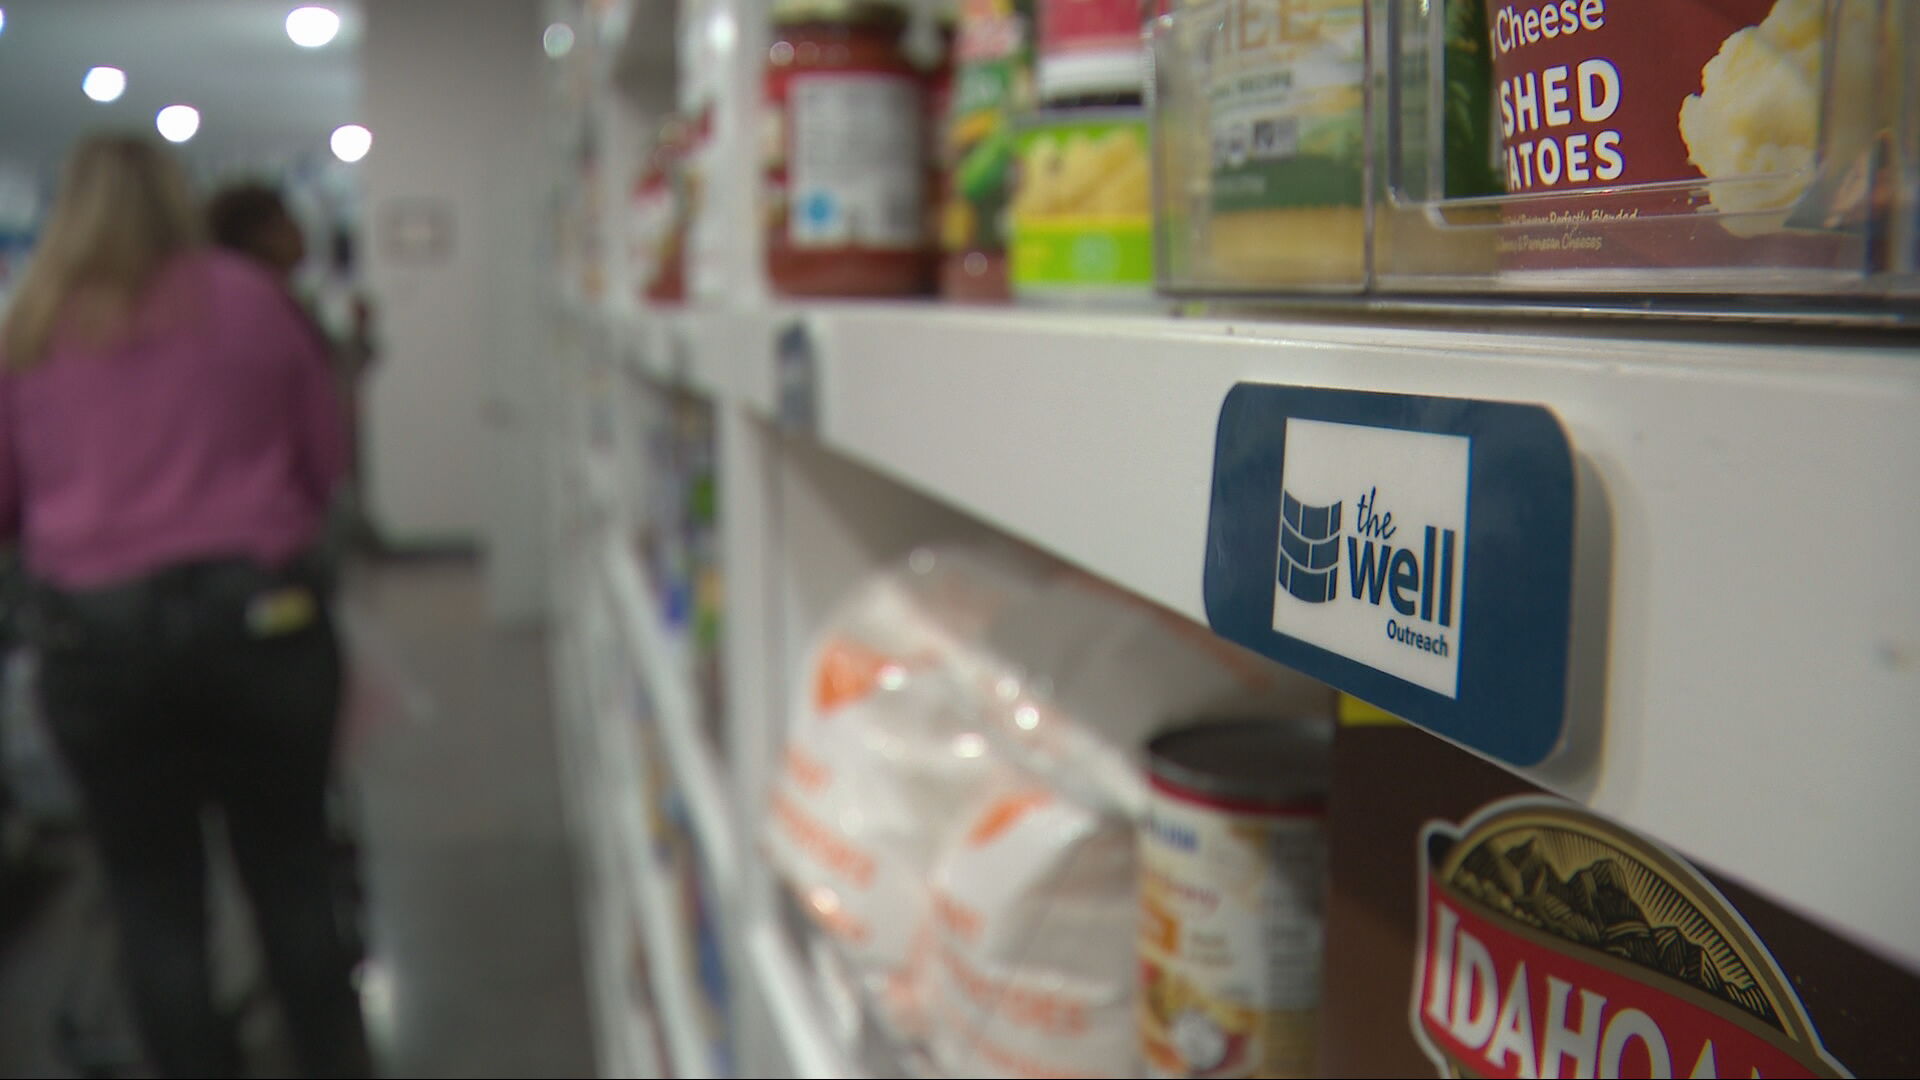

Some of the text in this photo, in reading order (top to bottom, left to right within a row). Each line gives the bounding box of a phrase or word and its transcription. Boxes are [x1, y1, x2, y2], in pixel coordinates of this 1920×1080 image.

[1497, 0, 1605, 53] Cheese
[1500, 59, 1621, 138] SHED
[1504, 130, 1624, 192] ATOES
[1357, 486, 1397, 540] the
[1386, 618, 1450, 658] Outreach
[1427, 903, 1762, 1079] IDAHO
